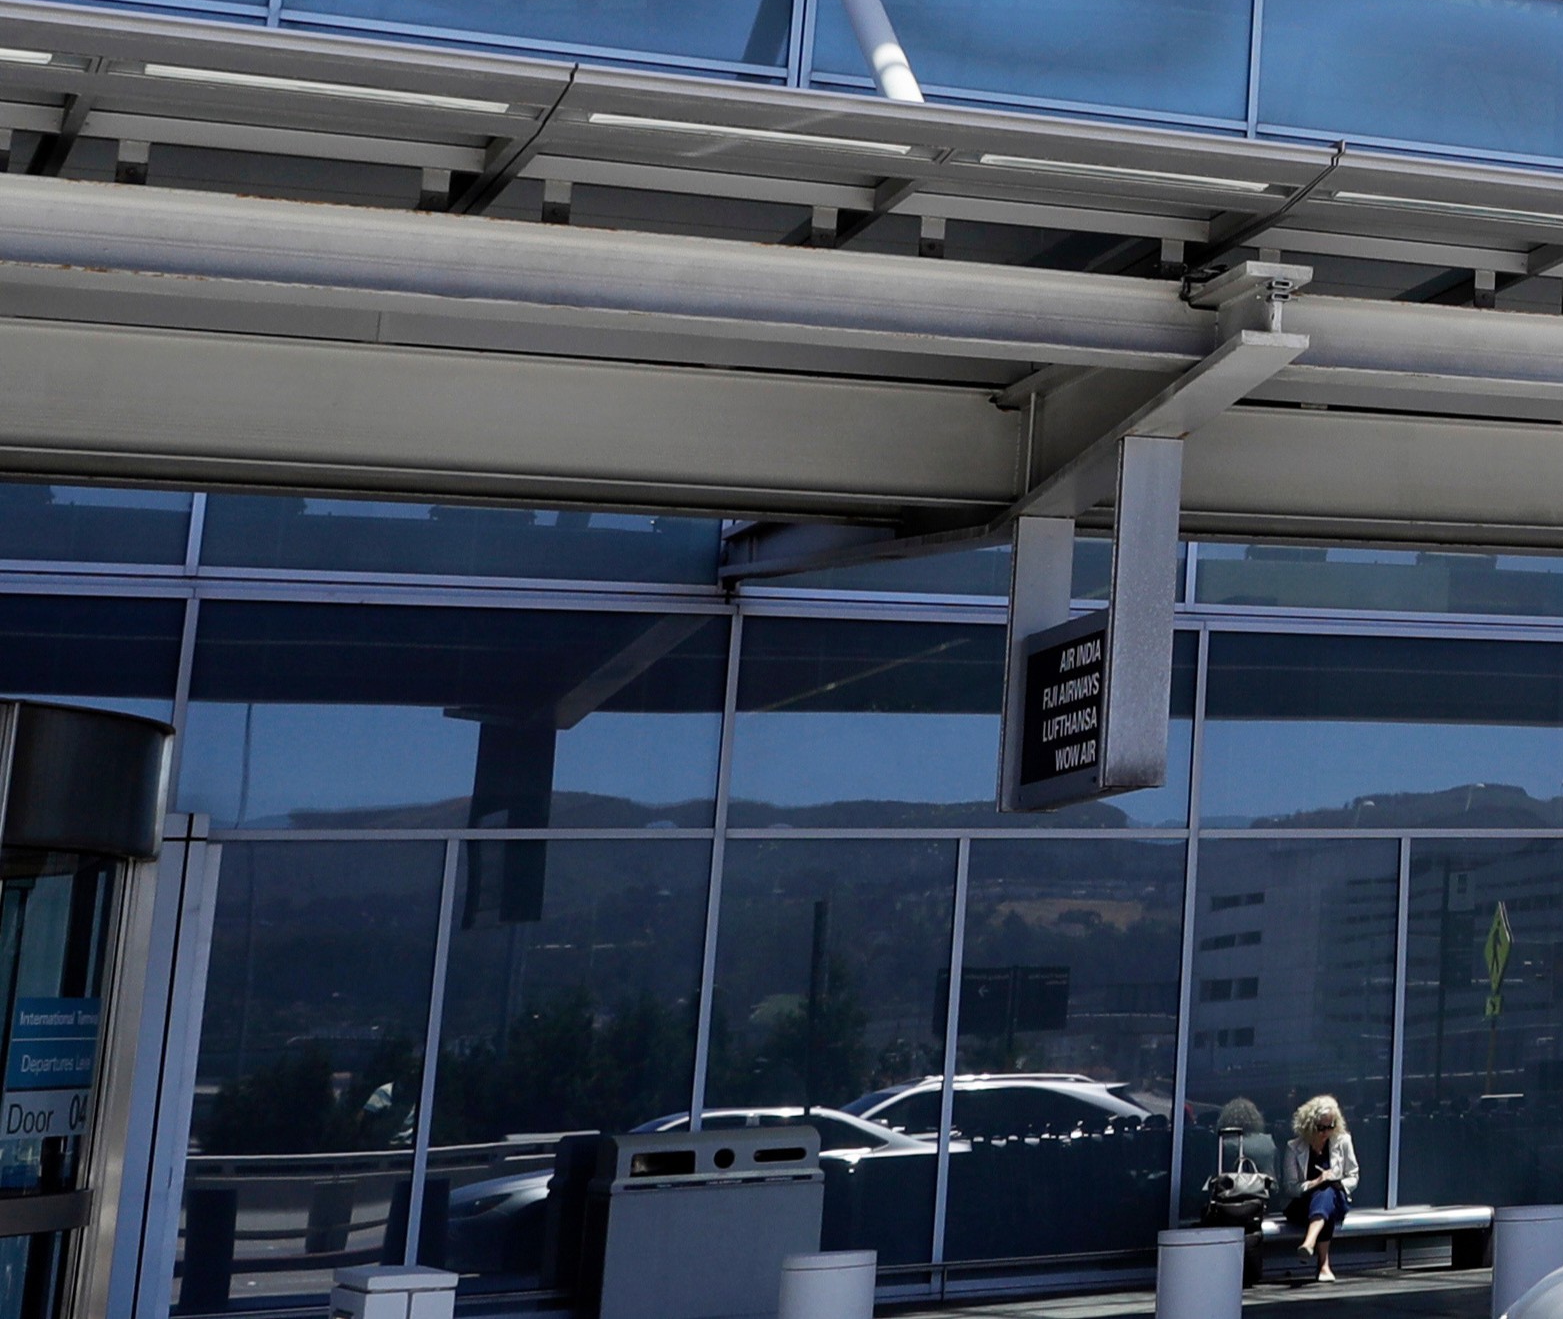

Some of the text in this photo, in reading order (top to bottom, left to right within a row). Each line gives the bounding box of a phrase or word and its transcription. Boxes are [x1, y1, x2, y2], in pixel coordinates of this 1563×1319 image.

[1059, 639, 1101, 673] AIR INDIA
[1043, 673, 1099, 710] FIJI AIRWAYS
[1043, 706, 1097, 742] LUFTHANSA
[1056, 740, 1096, 772] WOW AIR
[20, 1010, 74, 1025] International
[21, 1055, 74, 1075] Departures
[6, 1104, 54, 1134] Door
